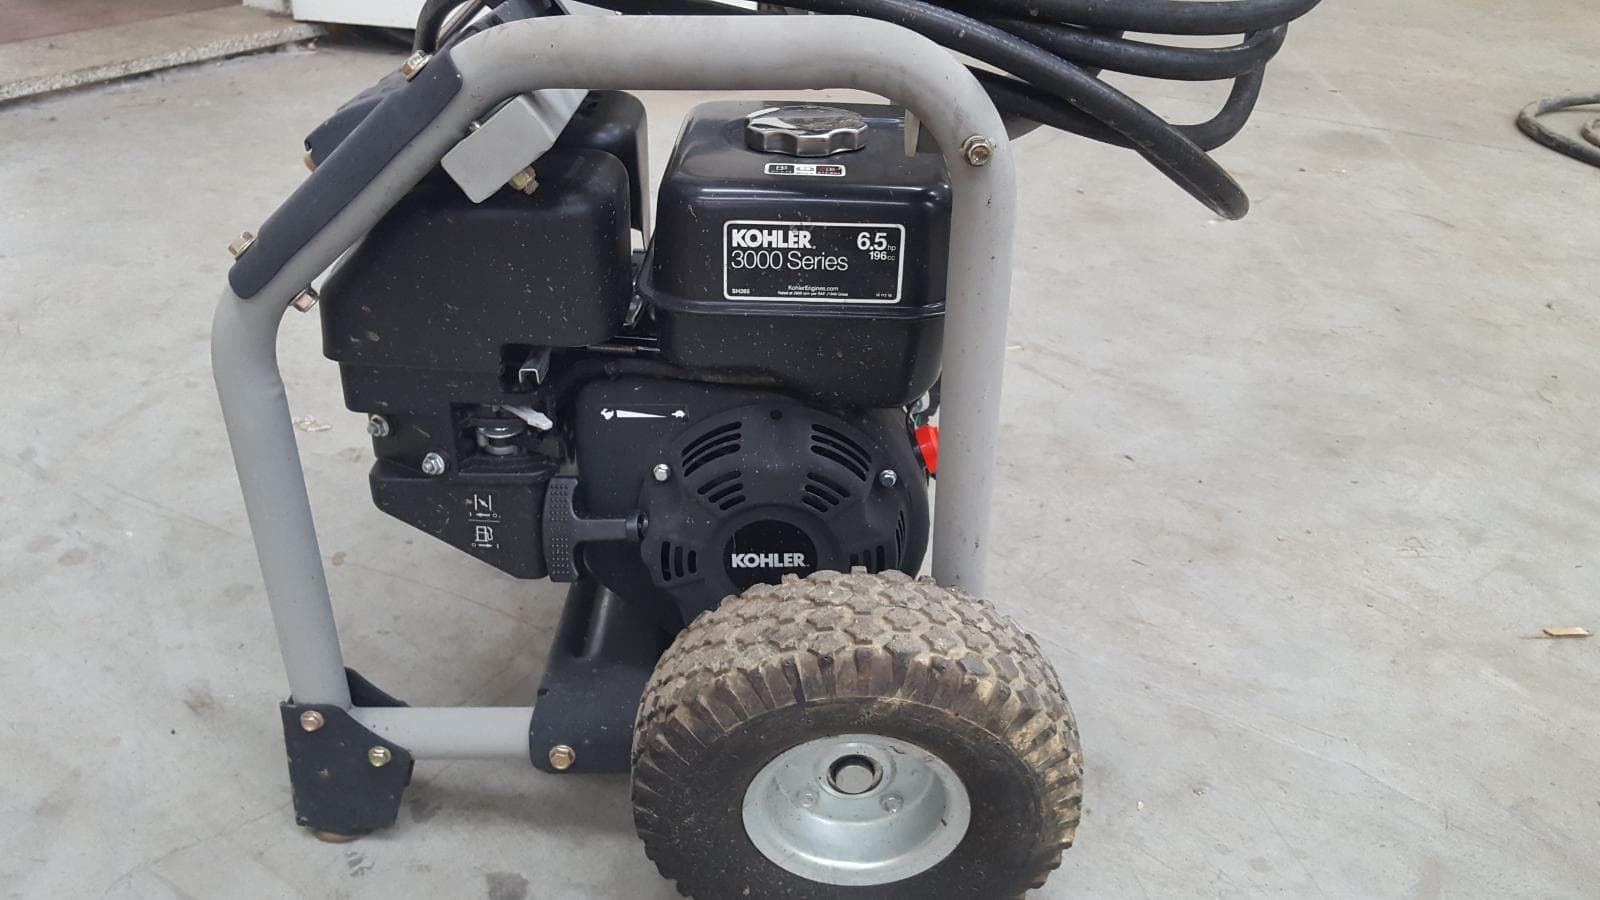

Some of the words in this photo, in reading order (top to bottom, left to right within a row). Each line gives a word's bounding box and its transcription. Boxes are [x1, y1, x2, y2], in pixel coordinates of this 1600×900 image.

[731, 229, 812, 249] KOHLER
[731, 250, 783, 269] 3000
[787, 250, 849, 271] Series
[731, 552, 806, 568] KOHLER
